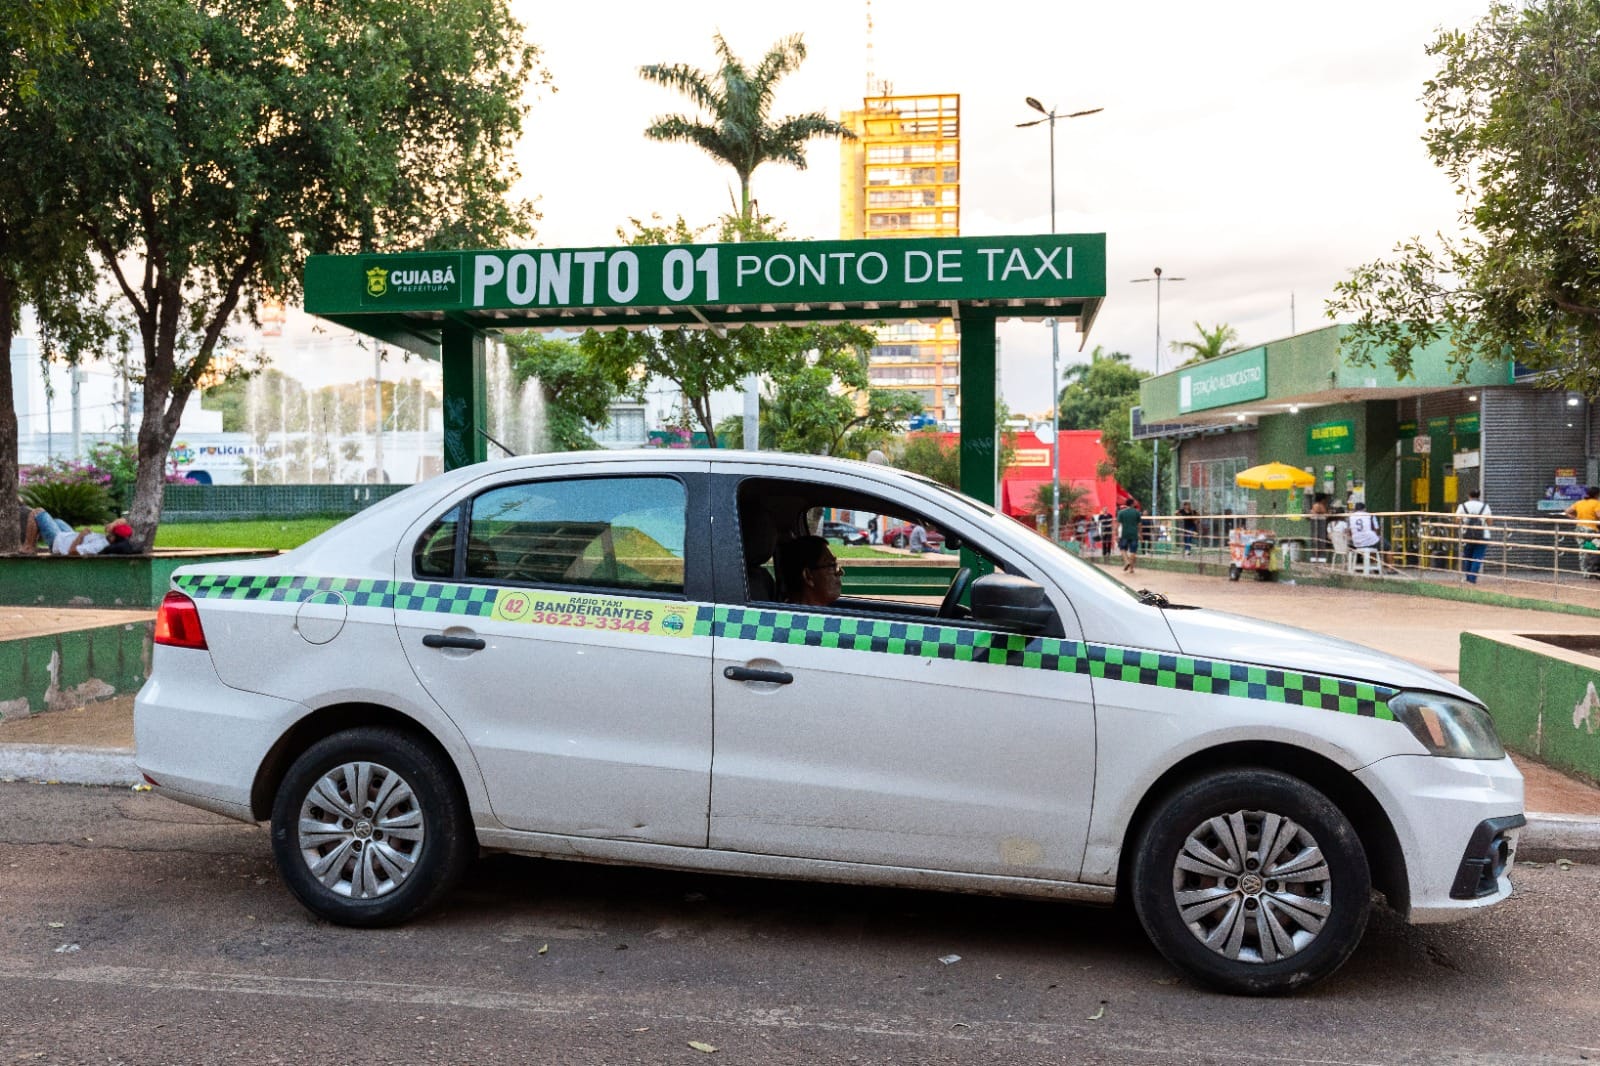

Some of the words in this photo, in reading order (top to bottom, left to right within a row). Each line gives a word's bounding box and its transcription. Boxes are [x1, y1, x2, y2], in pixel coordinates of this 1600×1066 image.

[390, 265, 456, 286] CUIABÁ
[473, 249, 640, 307] PONTO
[661, 246, 720, 303] 01
[736, 253, 889, 287] PONTO
[903, 249, 963, 284] DE
[977, 246, 1074, 281] TAXI
[398, 285, 449, 293] PREFEITURA
[505, 598, 524, 614] 42
[534, 601, 654, 621] BANDEIRANTES
[601, 599, 623, 608] TAXI
[531, 612, 651, 634] 3623-3344
